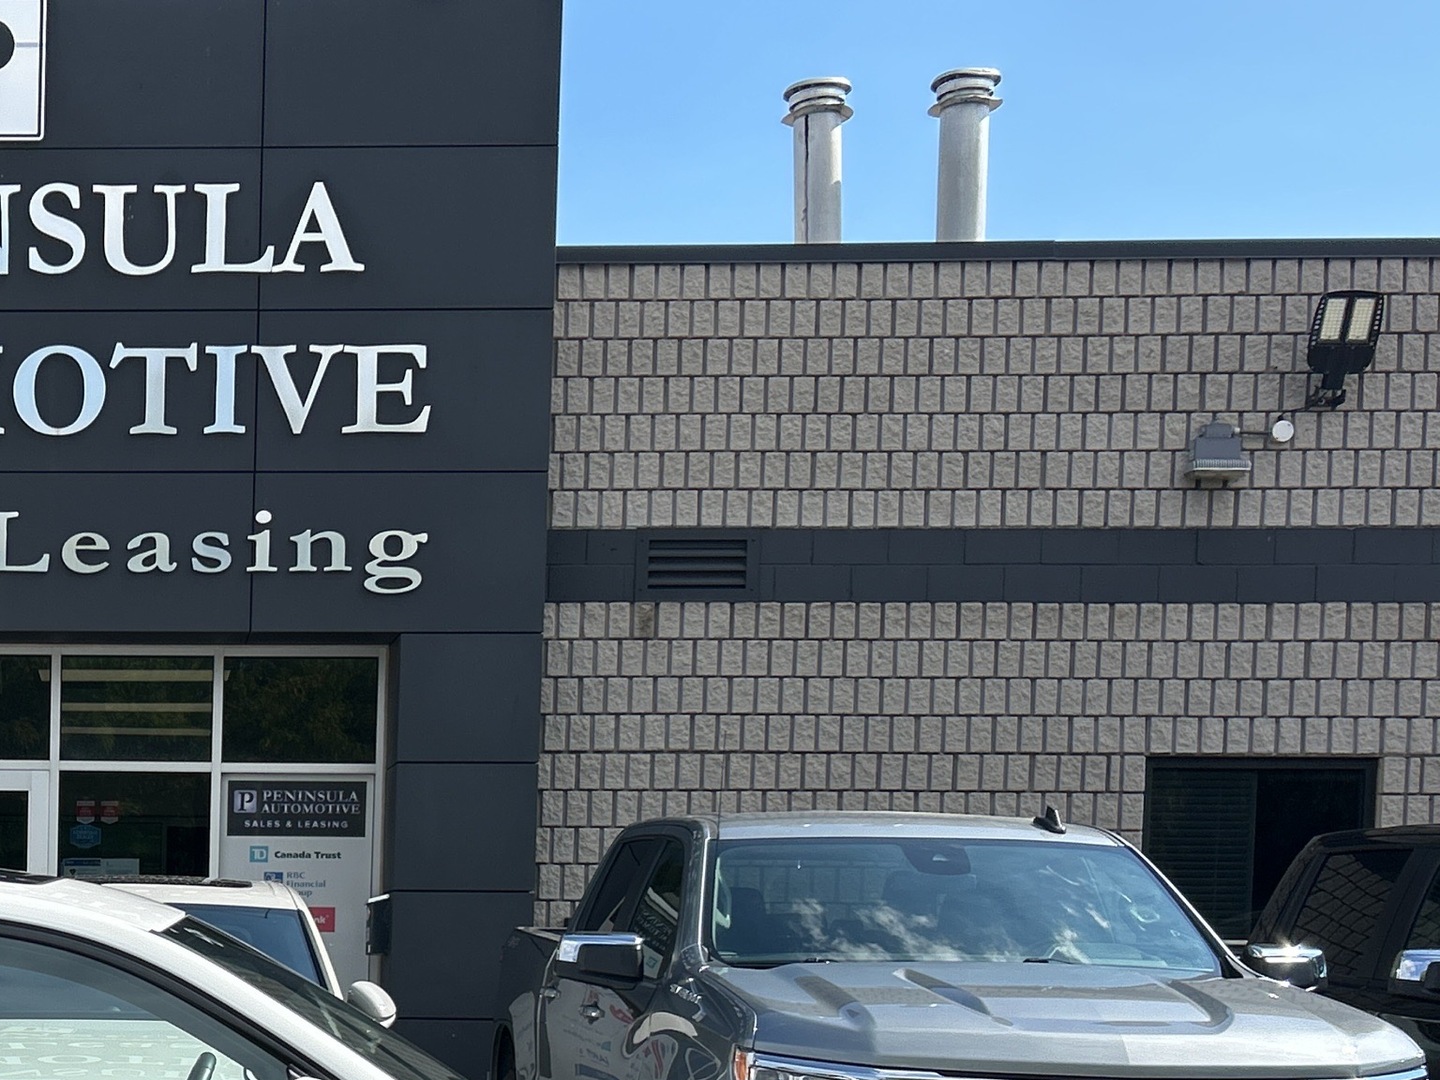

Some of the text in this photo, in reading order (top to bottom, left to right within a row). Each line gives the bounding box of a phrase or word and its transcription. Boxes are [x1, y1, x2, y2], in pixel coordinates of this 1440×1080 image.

[239, 790, 359, 812] P PENINSULA
[261, 803, 361, 815] AUTOMOTIVE
[244, 820, 281, 828] SALES
[298, 820, 348, 829] LEASING
[252, 848, 342, 860] TD Canada Trust
[286, 871, 306, 879] RBC
[286, 880, 326, 888] Financial
